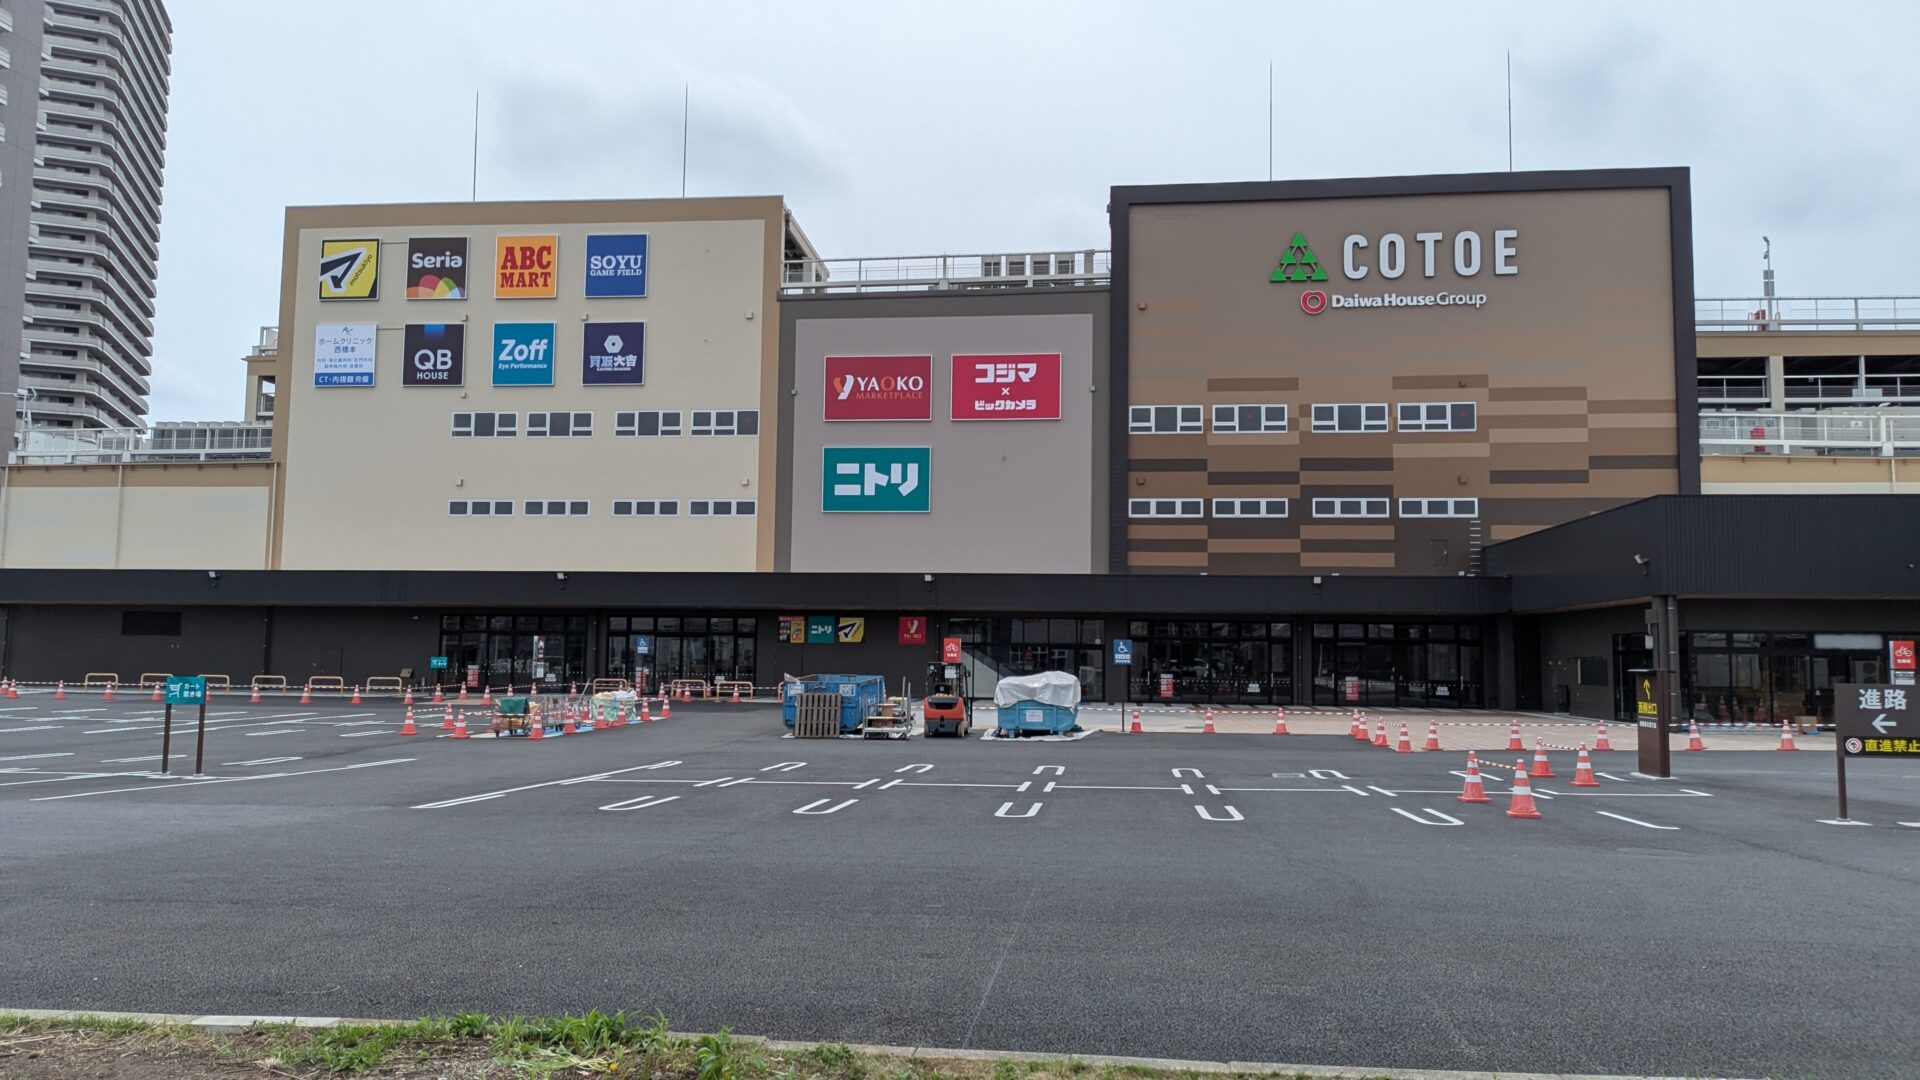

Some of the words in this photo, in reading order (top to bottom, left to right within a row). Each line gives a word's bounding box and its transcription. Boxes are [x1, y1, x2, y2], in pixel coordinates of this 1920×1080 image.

[411, 251, 463, 268] Seria
[501, 245, 552, 270] ABC
[590, 254, 643, 270] SOYU
[1342, 229, 1519, 280] COTOE
[350, 254, 373, 287] matsukiyo
[590, 269, 615, 277] GAME
[617, 268, 642, 276] FIELD
[500, 271, 551, 288] MART
[1331, 294, 1384, 309] Daiwa
[1384, 292, 1436, 307] House
[1436, 291, 1487, 309] Group
[318, 337, 373, 346] ホームクリニック
[334, 345, 357, 354] 西橋本
[498, 338, 549, 361] Zoff
[414, 349, 453, 371] QB
[498, 362, 509, 370] Eye
[589, 354, 638, 368] 買取大吉
[416, 371, 449, 380] HOUSE
[974, 362, 1038, 383] コジマ
[856, 375, 924, 392] YAOKO
[855, 391, 924, 400] MARKETPLACE
[974, 399, 1037, 411] ビックカメラ
[833, 462, 919, 497] ニトリ
[810, 625, 832, 634] ニトリ
[1858, 688, 1908, 710] 進路
[1864, 739, 1920, 752] 直進禁止
